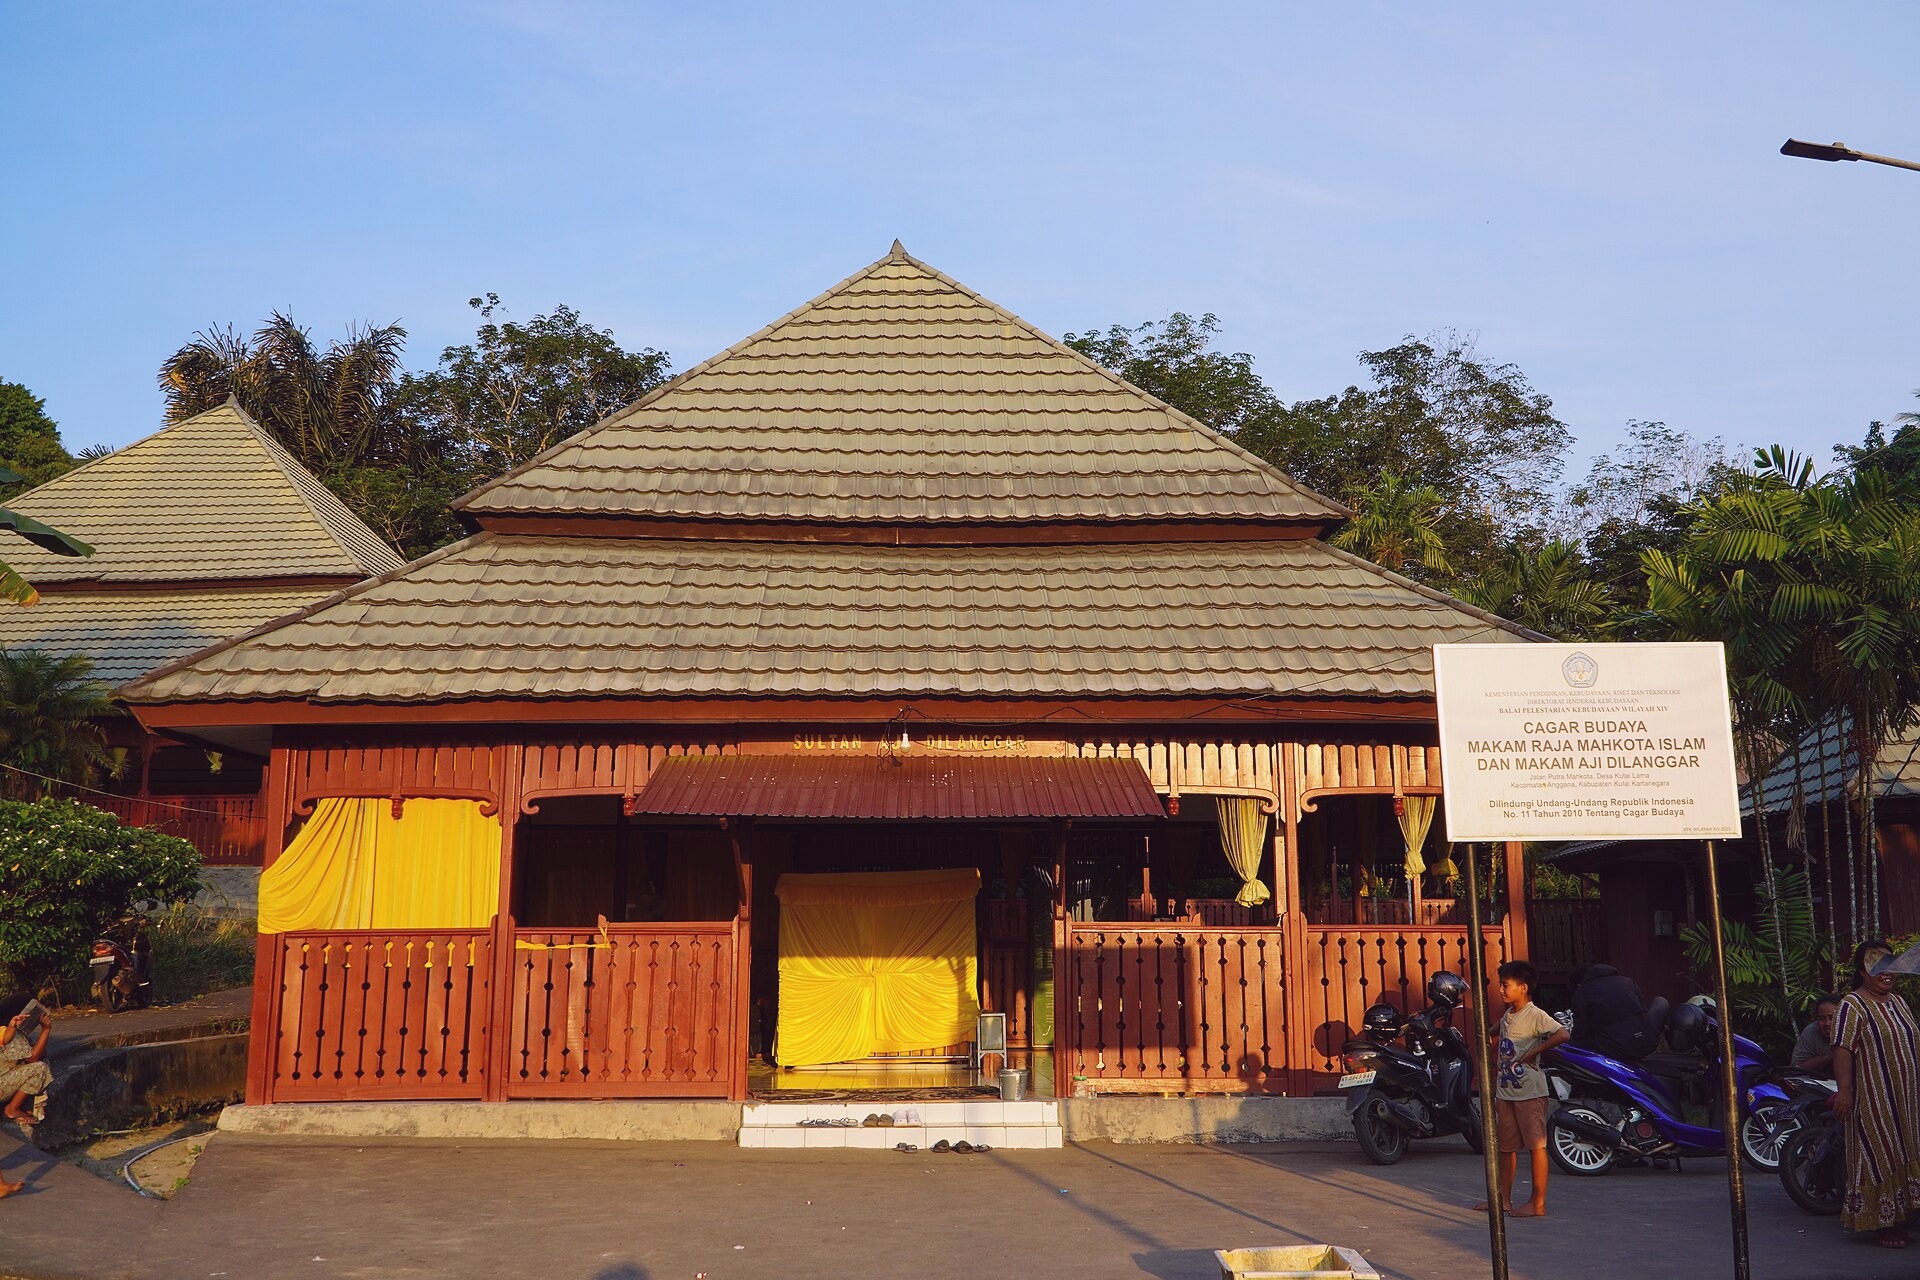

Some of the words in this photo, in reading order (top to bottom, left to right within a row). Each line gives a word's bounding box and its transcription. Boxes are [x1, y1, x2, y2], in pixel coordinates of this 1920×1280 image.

[1523, 721, 1580, 734] CAGAR
[1584, 720, 1647, 733] BUDAYA
[792, 733, 862, 750] SULTAN
[926, 733, 1027, 750] DILANGGAR
[1468, 740, 1527, 753] MAKAM
[1531, 740, 1573, 752] RAJA
[1577, 739, 1655, 751] MAHKOTA
[1658, 738, 1706, 750] ISLAM
[1477, 758, 1510, 771] DAN
[1515, 757, 1574, 770] MAKAM
[1578, 756, 1602, 769] AJI
[1607, 755, 1700, 768] DILANGGAR
[1566, 773, 1595, 781] Mahkota,
[1578, 781, 1613, 789] Kabupaten
[1631, 780, 1670, 788] Kartanegara
[1489, 799, 1534, 809] Dilindungi
[1536, 798, 1608, 808] Undang-Undang
[1610, 797, 1649, 807] Republik
[1651, 797, 1694, 806] Indonesia
[1503, 810, 1518, 818] No.
[1520, 810, 1530, 818] 11
[1532, 809, 1560, 818] Tahun
[1562, 809, 1583, 818] 2010
[1585, 809, 1621, 819] Tentang
[1622, 808, 1649, 818] Cagar
[1651, 808, 1685, 818] Budaya
